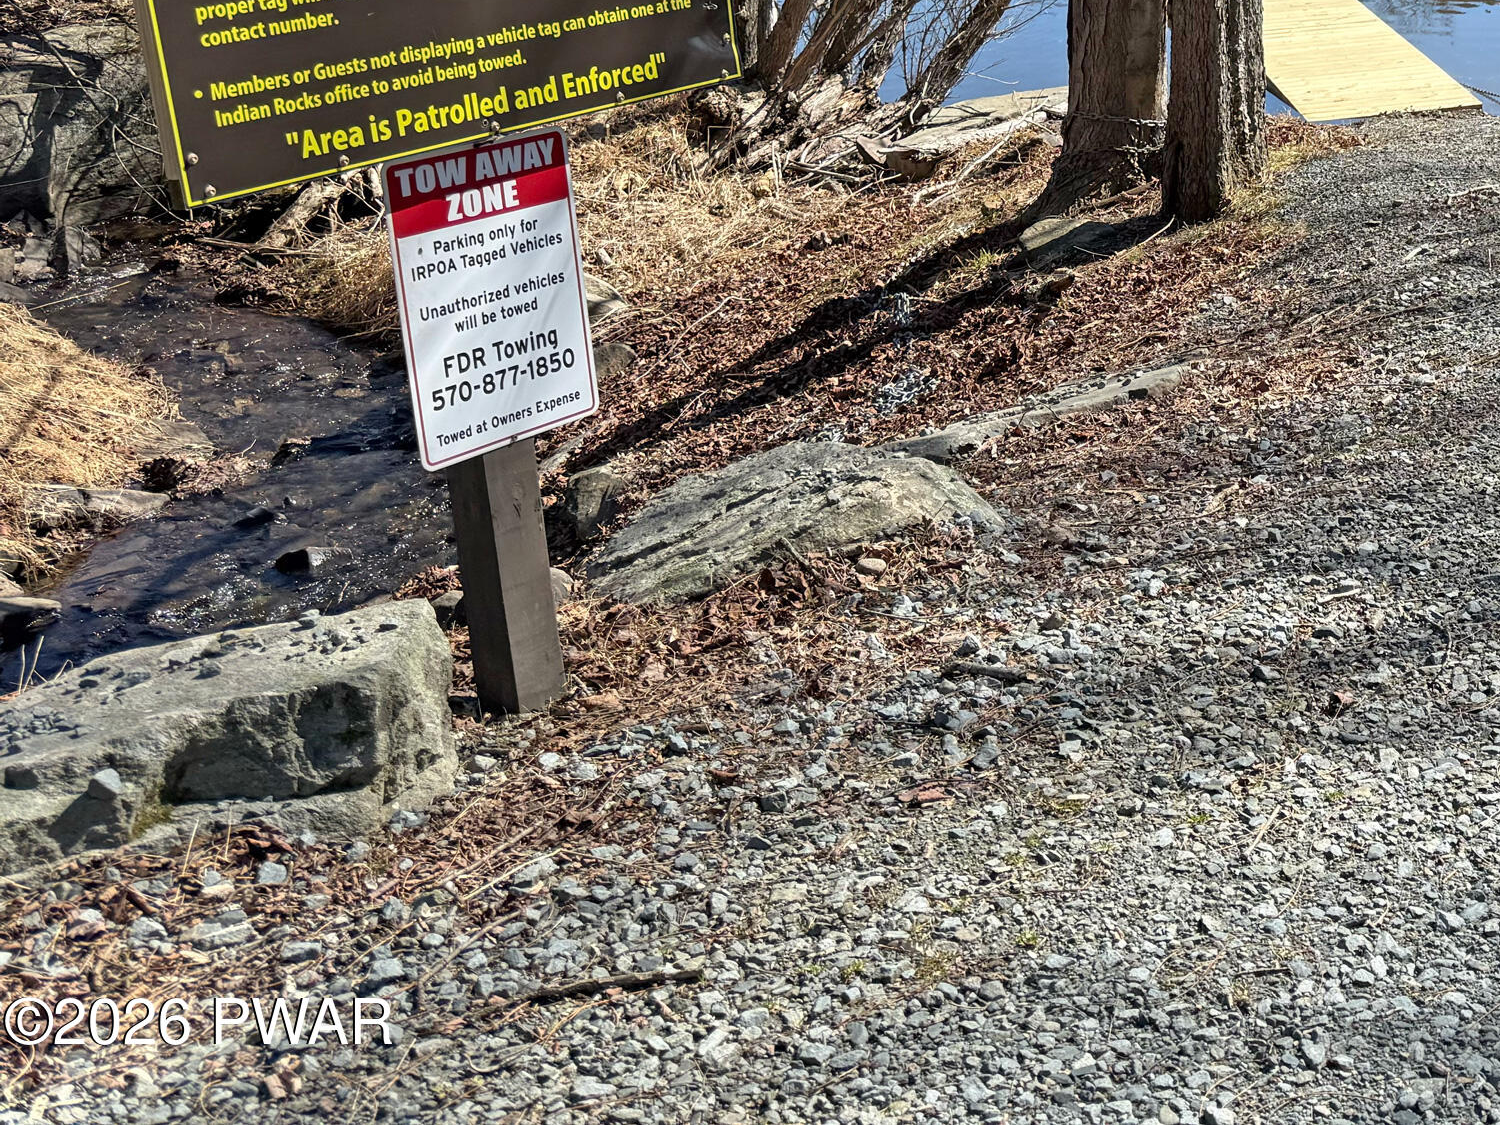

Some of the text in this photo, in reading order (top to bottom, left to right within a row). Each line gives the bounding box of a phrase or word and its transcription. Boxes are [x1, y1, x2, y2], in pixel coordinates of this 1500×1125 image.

[200, 12, 340, 48] contact number.
[209, 73, 291, 101] Members
[292, 69, 311, 85] or
[313, 58, 368, 80] Guests
[369, 51, 398, 70] not
[399, 37, 475, 64] displaying
[476, 36, 486, 49] a
[486, 23, 536, 47] vehicle
[537, 22, 561, 38] tag
[562, 17, 586, 32] can
[587, 6, 630, 27] obtain
[630, 4, 655, 19] one
[656, 0, 670, 14] at
[214, 49, 527, 128] Indian Rocks office to avoid being towed.
[285, 52, 666, 159] "Area is Patrolled and Enforced"
[394, 137, 555, 198] TOW AWAY
[445, 179, 520, 222] ZONE
[411, 233, 563, 282] IRPOA Tagged Vehicles
[433, 218, 538, 255] Parking only for
[419, 271, 565, 322] Unauthorized vehicles
[454, 296, 538, 333] will be towed
[443, 328, 558, 378] FDR Towing
[431, 347, 575, 412] 570-877-1850
[436, 390, 581, 447] Towed at Owners Expense
